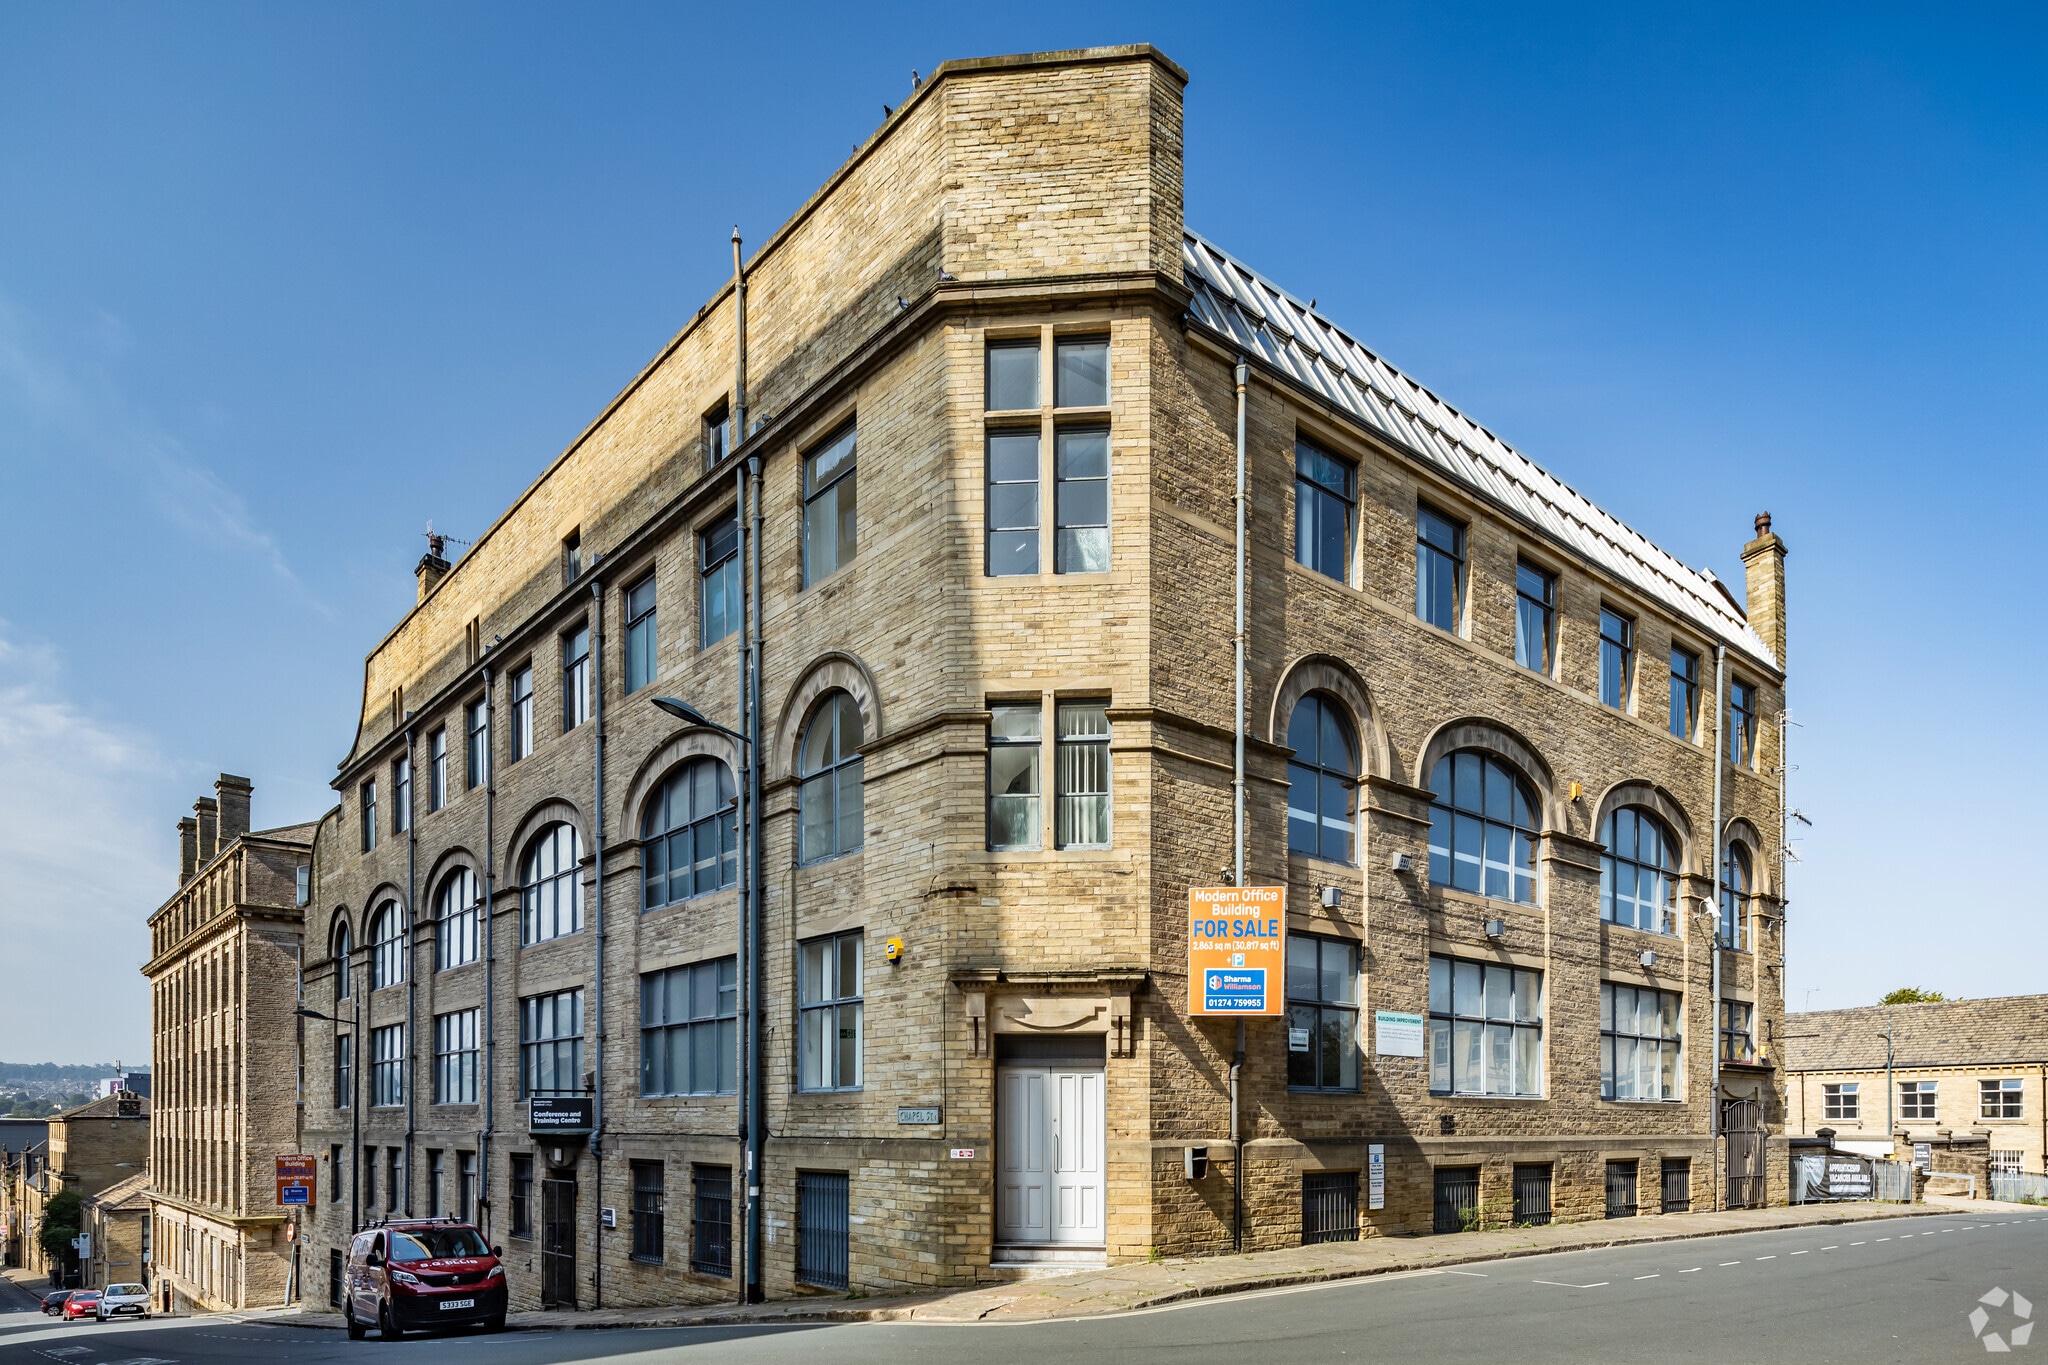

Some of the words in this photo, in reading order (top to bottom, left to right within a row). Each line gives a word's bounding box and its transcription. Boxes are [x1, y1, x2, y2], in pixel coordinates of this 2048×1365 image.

[1195, 890, 1239, 902] Modern
[1242, 889, 1278, 902] Office
[1212, 904, 1260, 918] Building
[1193, 919, 1228, 937] FOR
[1233, 919, 1278, 937] SALE
[1193, 941, 1213, 951] 2,863
[1214, 942, 1223, 952] sq
[1224, 942, 1231, 950] m
[1232, 940, 1259, 951] (30,817
[1260, 942, 1269, 952] sq
[1270, 940, 1279, 951] ft)
[1224, 975, 1251, 983] Sharma
[1209, 999, 1232, 1007] 01274
[1234, 999, 1261, 1007] 759955
[900, 1111, 924, 1121] CHAPEL
[294, 1167, 312, 1175] SALE
